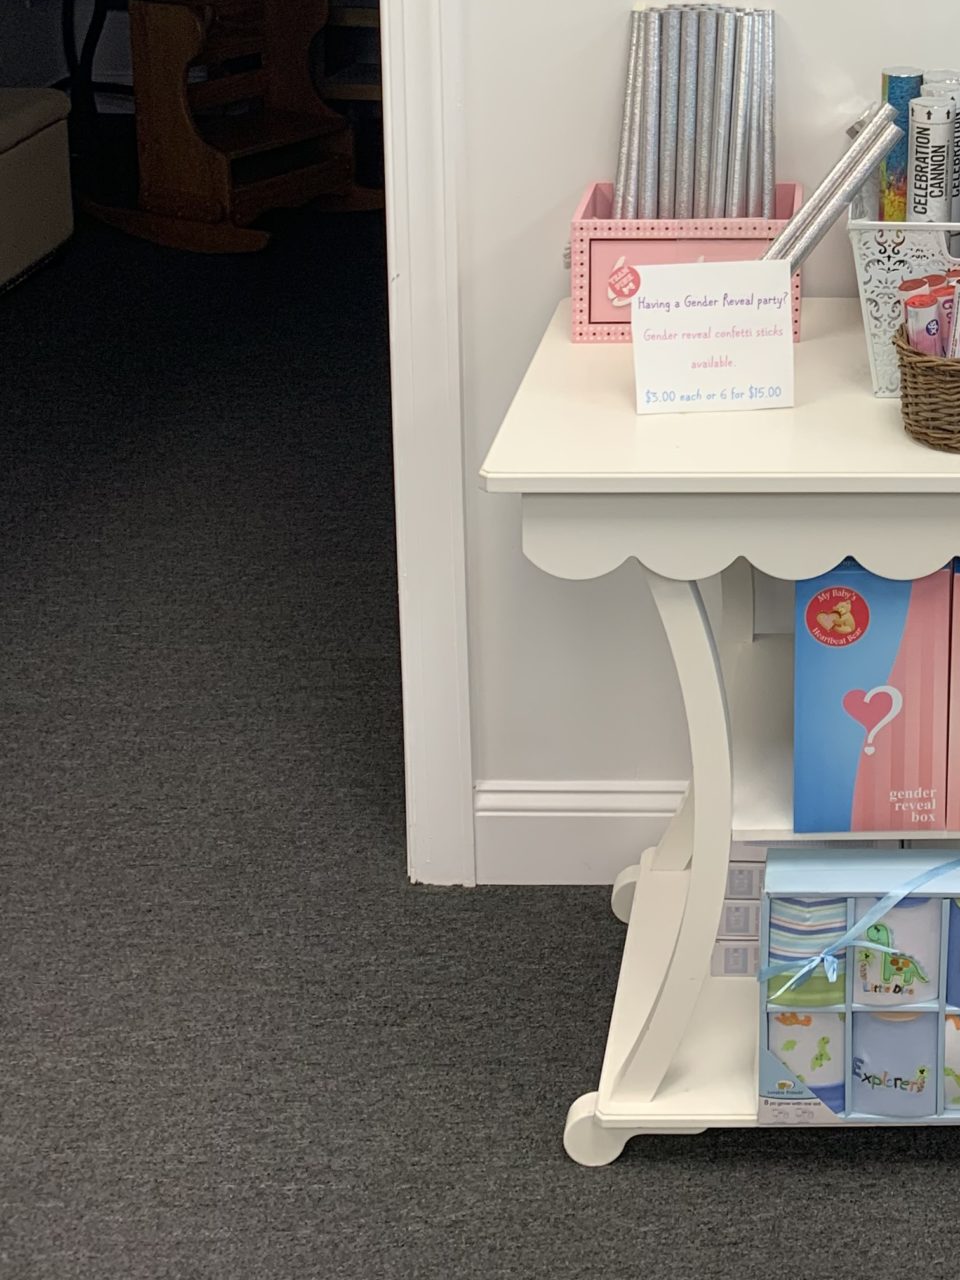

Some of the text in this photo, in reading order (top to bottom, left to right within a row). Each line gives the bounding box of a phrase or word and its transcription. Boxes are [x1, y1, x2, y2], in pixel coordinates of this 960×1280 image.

[913, 126, 931, 215] CELEBRATION
[929, 144, 946, 198] CANNON
[638, 291, 789, 312] Having a Gender Reveal party?
[643, 324, 784, 342] Gender reveal confetti sticks
[679, 388, 702, 402] each
[706, 392, 717, 400] or
[720, 389, 728, 400] 6
[731, 387, 745, 400] for
[748, 385, 783, 400] $15.00
[818, 592, 831, 602] My
[812, 627, 863, 645] Heartbeat Bear
[889, 787, 937, 801] gender
[895, 799, 936, 811] reveal
[911, 812, 936, 823] box
